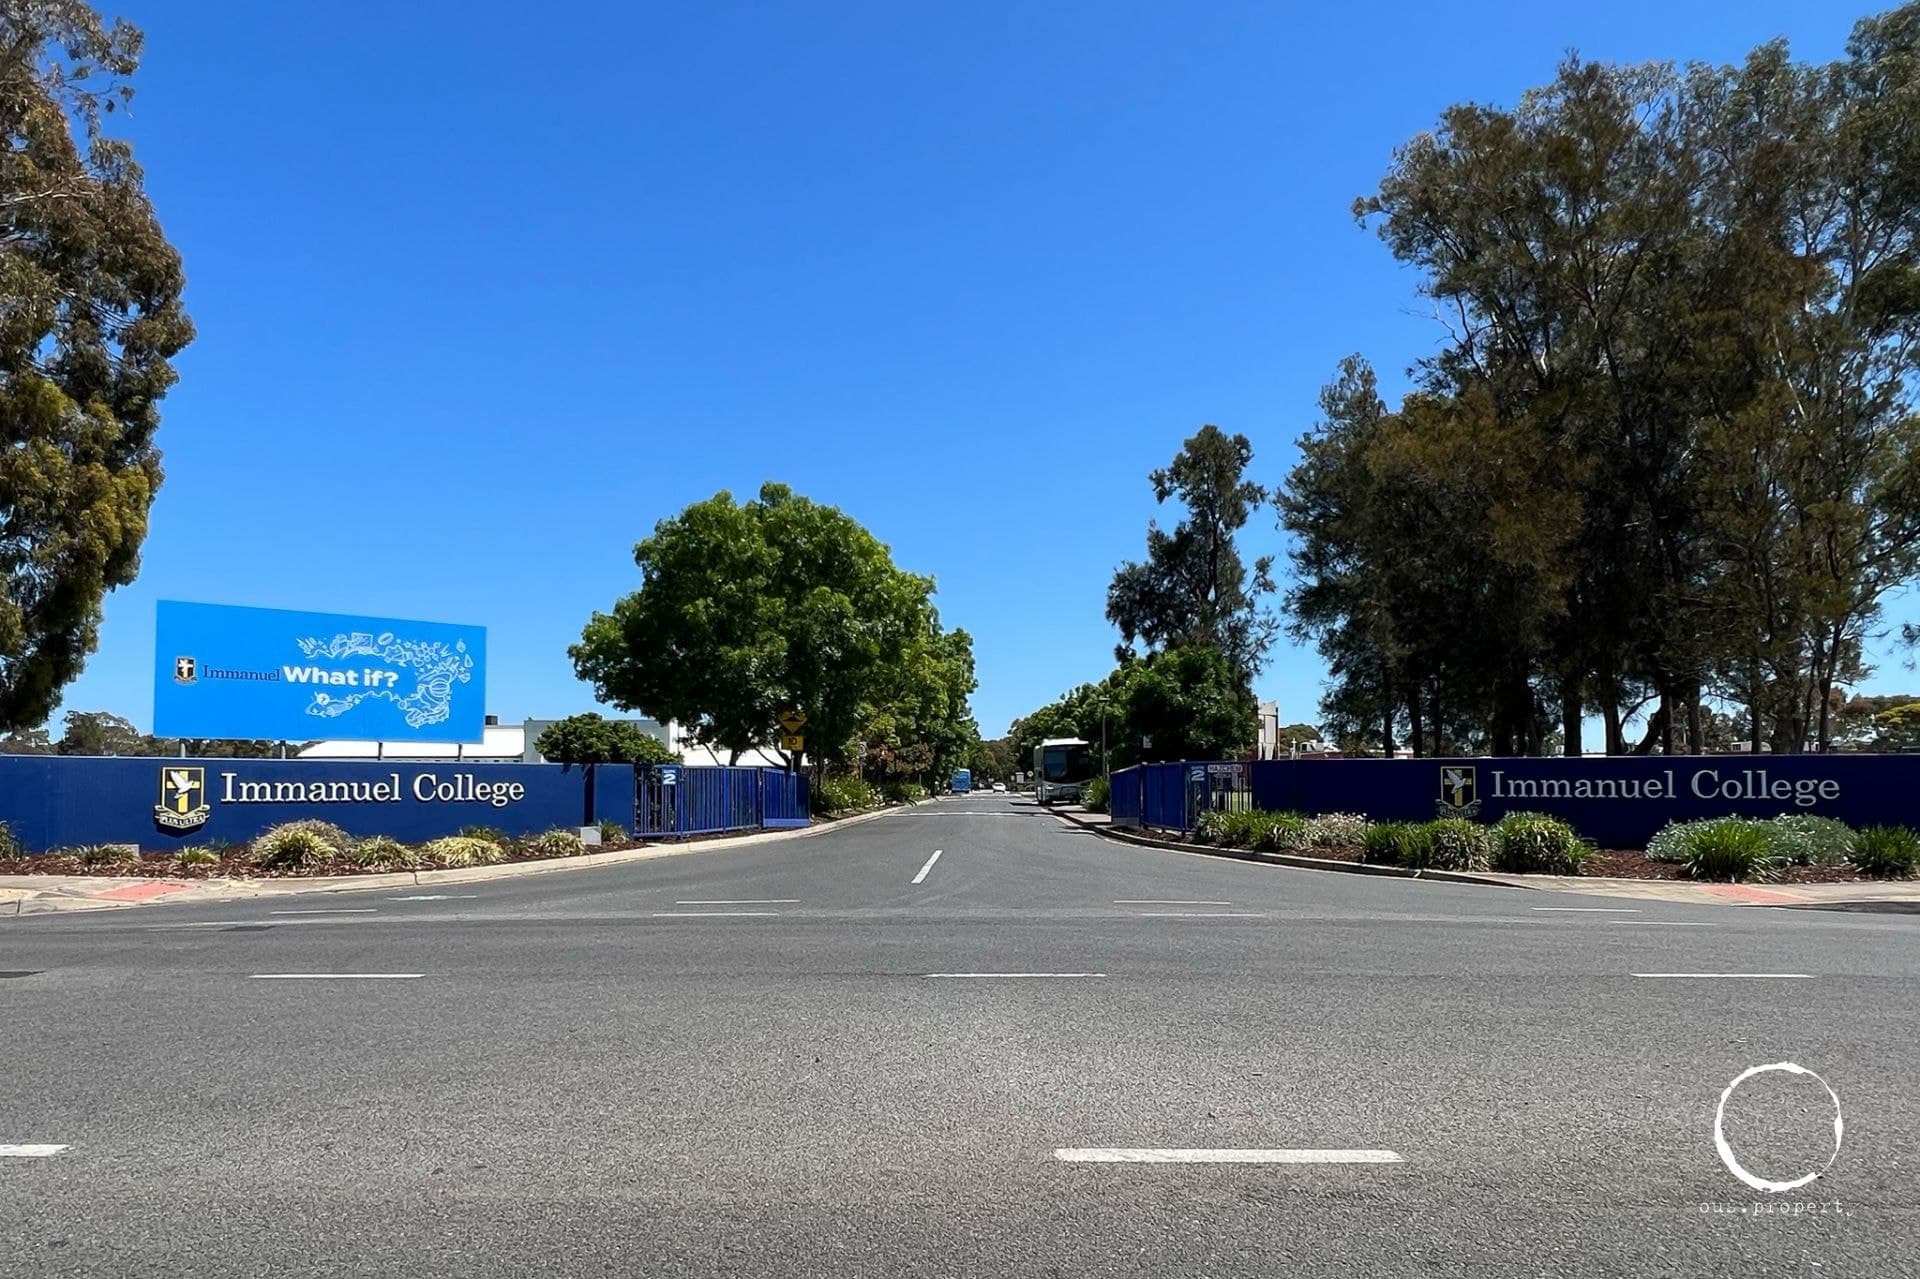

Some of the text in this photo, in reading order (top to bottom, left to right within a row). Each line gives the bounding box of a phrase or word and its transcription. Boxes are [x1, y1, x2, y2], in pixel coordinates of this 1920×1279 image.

[203, 664, 399, 688] Immanuel What if?
[663, 773, 676, 785] 2
[1191, 770, 1205, 782] 2
[220, 771, 525, 808] Immanuel College
[1491, 769, 1841, 808] Immanuel College
